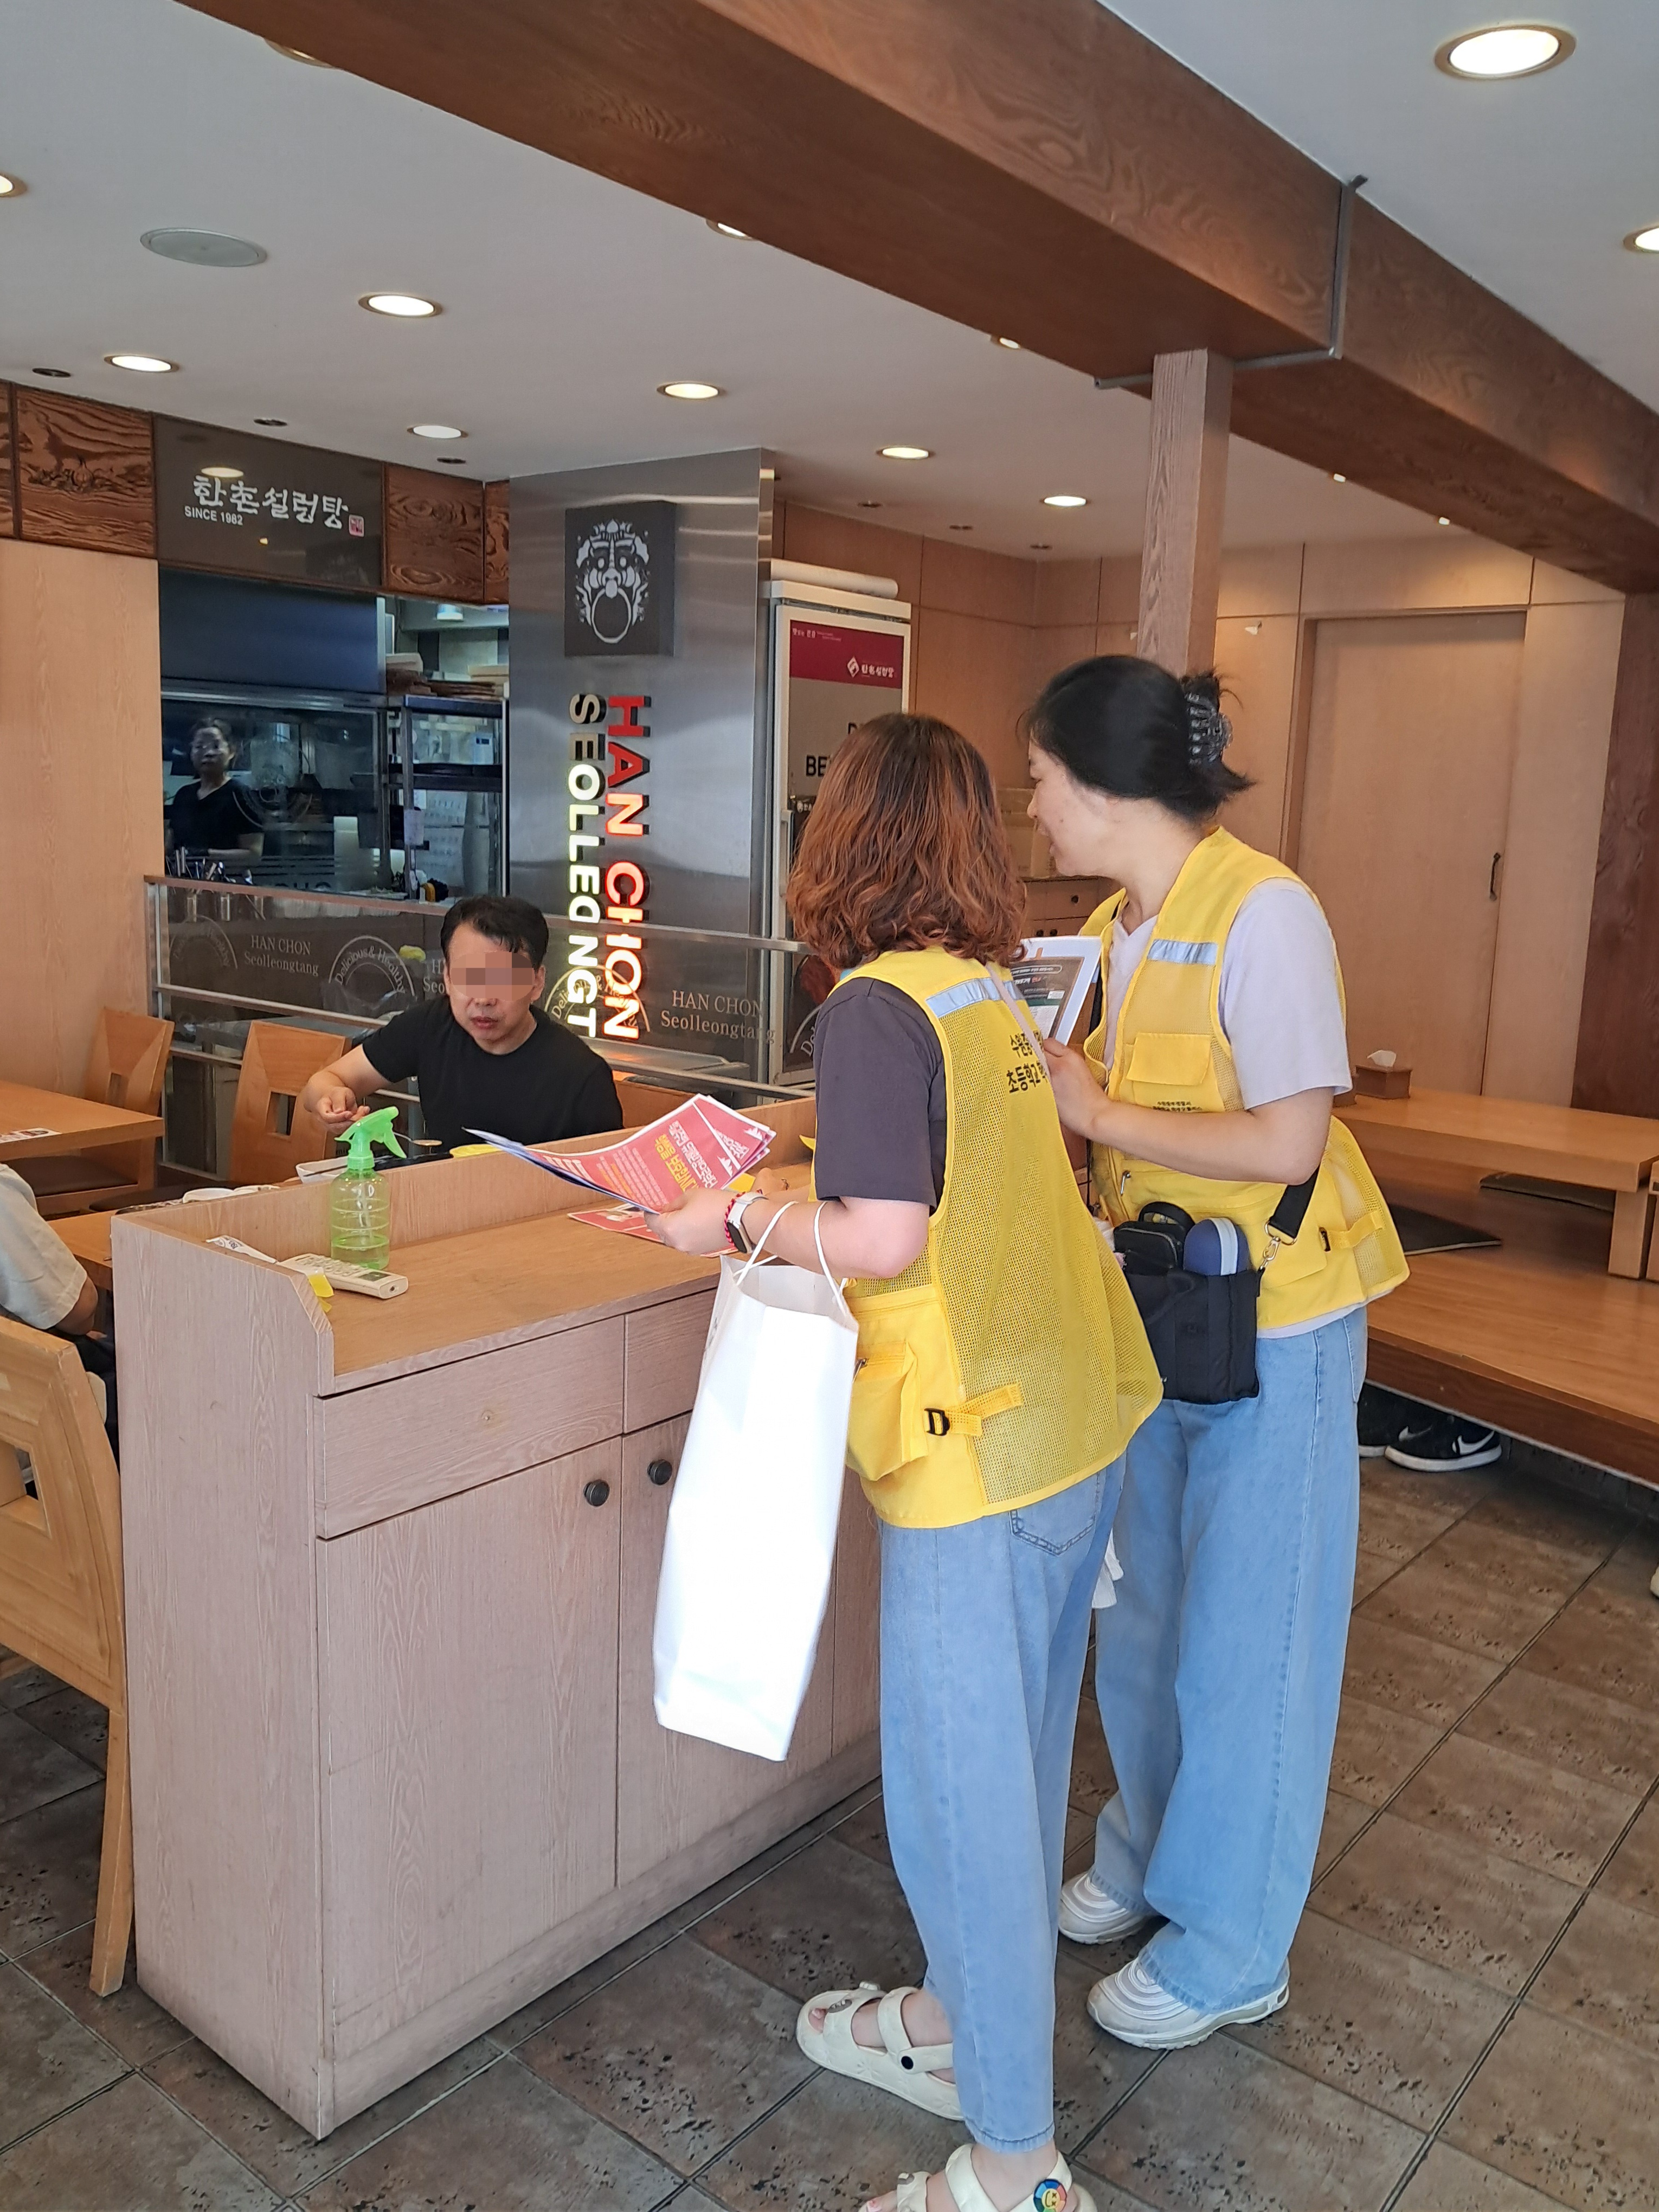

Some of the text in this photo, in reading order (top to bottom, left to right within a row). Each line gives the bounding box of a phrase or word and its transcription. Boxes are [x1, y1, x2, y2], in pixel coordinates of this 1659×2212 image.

[184, 505, 243, 526] SINCE 1982
[193, 475, 349, 530] 한촌설렁탕
[606, 695, 651, 837] HAN
[251, 935, 311, 955] HAN CHON
[603, 861, 647, 1040] CHON
[245, 951, 319, 977] Seolleongtang
[335, 947, 369, 986] Delicious
[672, 989, 763, 1018] HAN CHON
[1006, 1063, 1041, 1094] 초등학교
